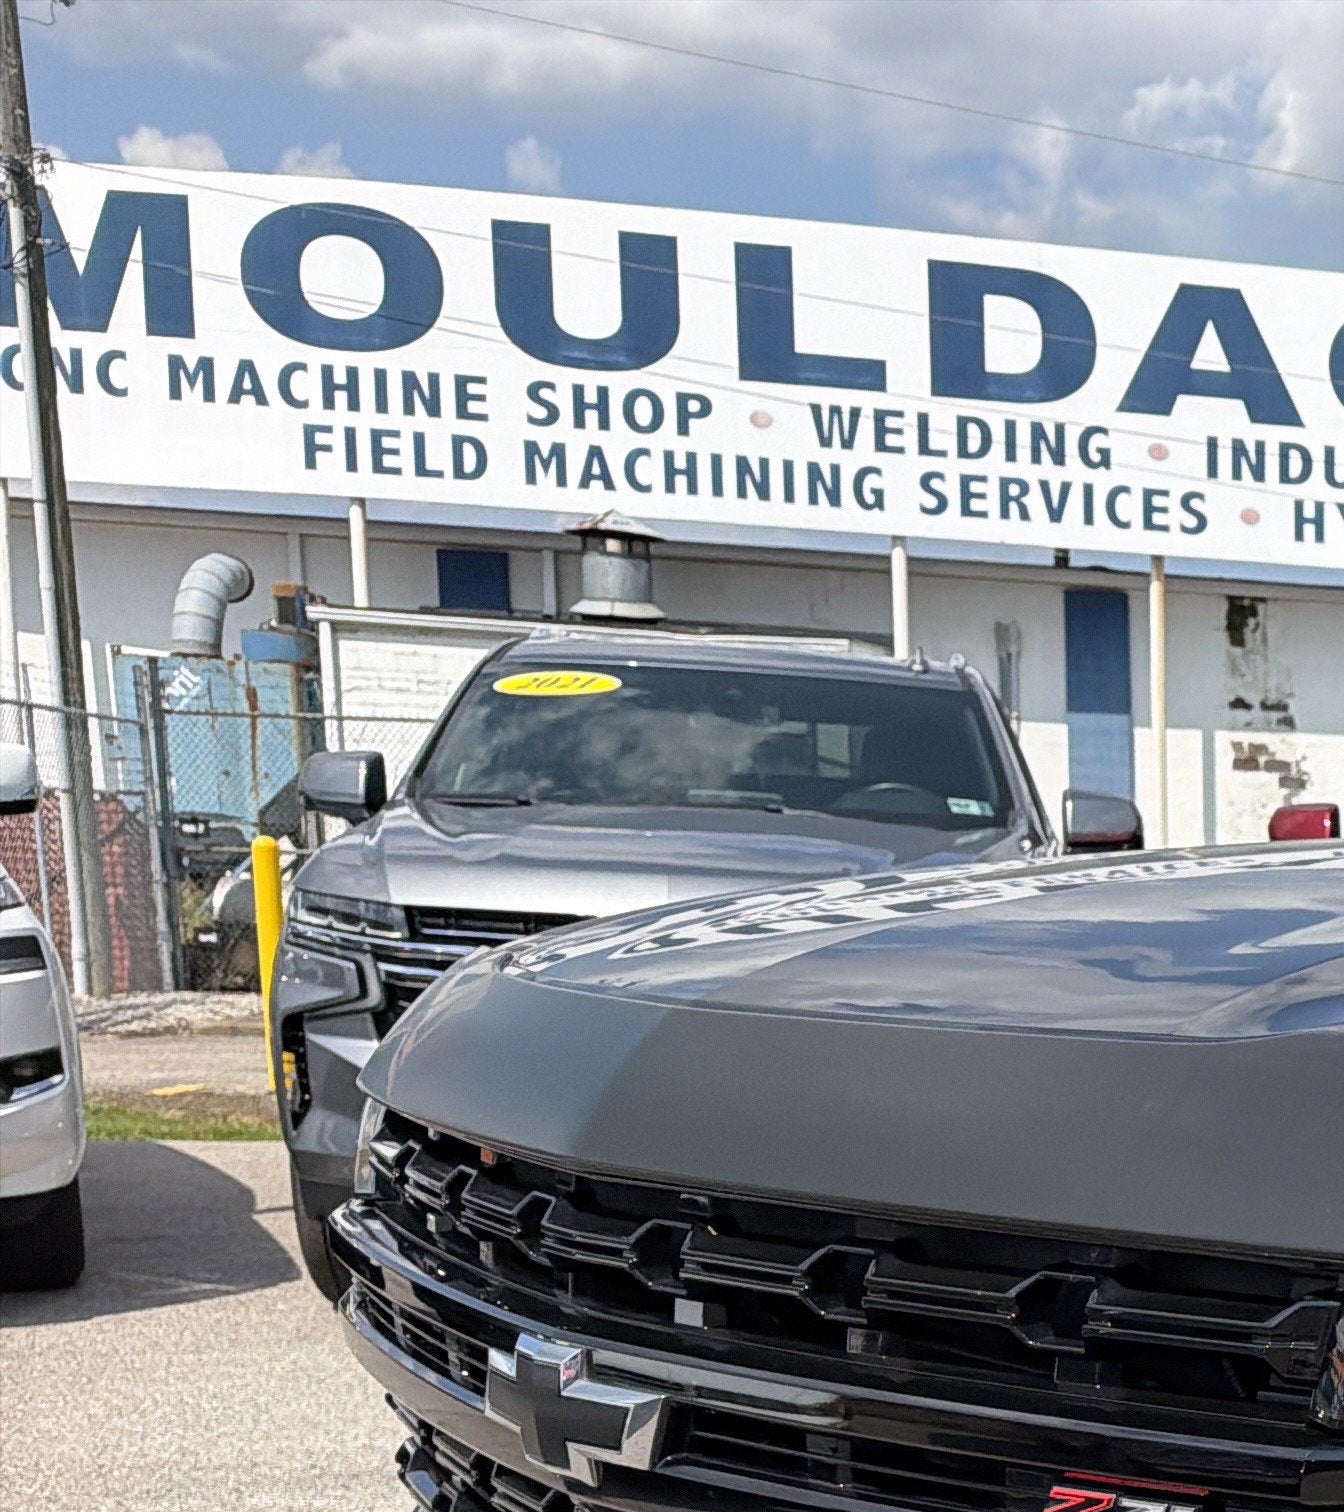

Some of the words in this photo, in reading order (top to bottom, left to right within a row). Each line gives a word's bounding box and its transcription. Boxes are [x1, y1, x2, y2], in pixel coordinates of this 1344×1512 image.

[0, 343, 129, 398] CNC
[168, 354, 490, 423] MACHINE
[526, 379, 714, 438] SHOP
[809, 402, 1114, 471] WELDING
[303, 422, 488, 483] FIELD
[524, 439, 887, 512] MACHINING
[918, 470, 1209, 535] SERVICES
[515, 676, 598, 690] 2021
